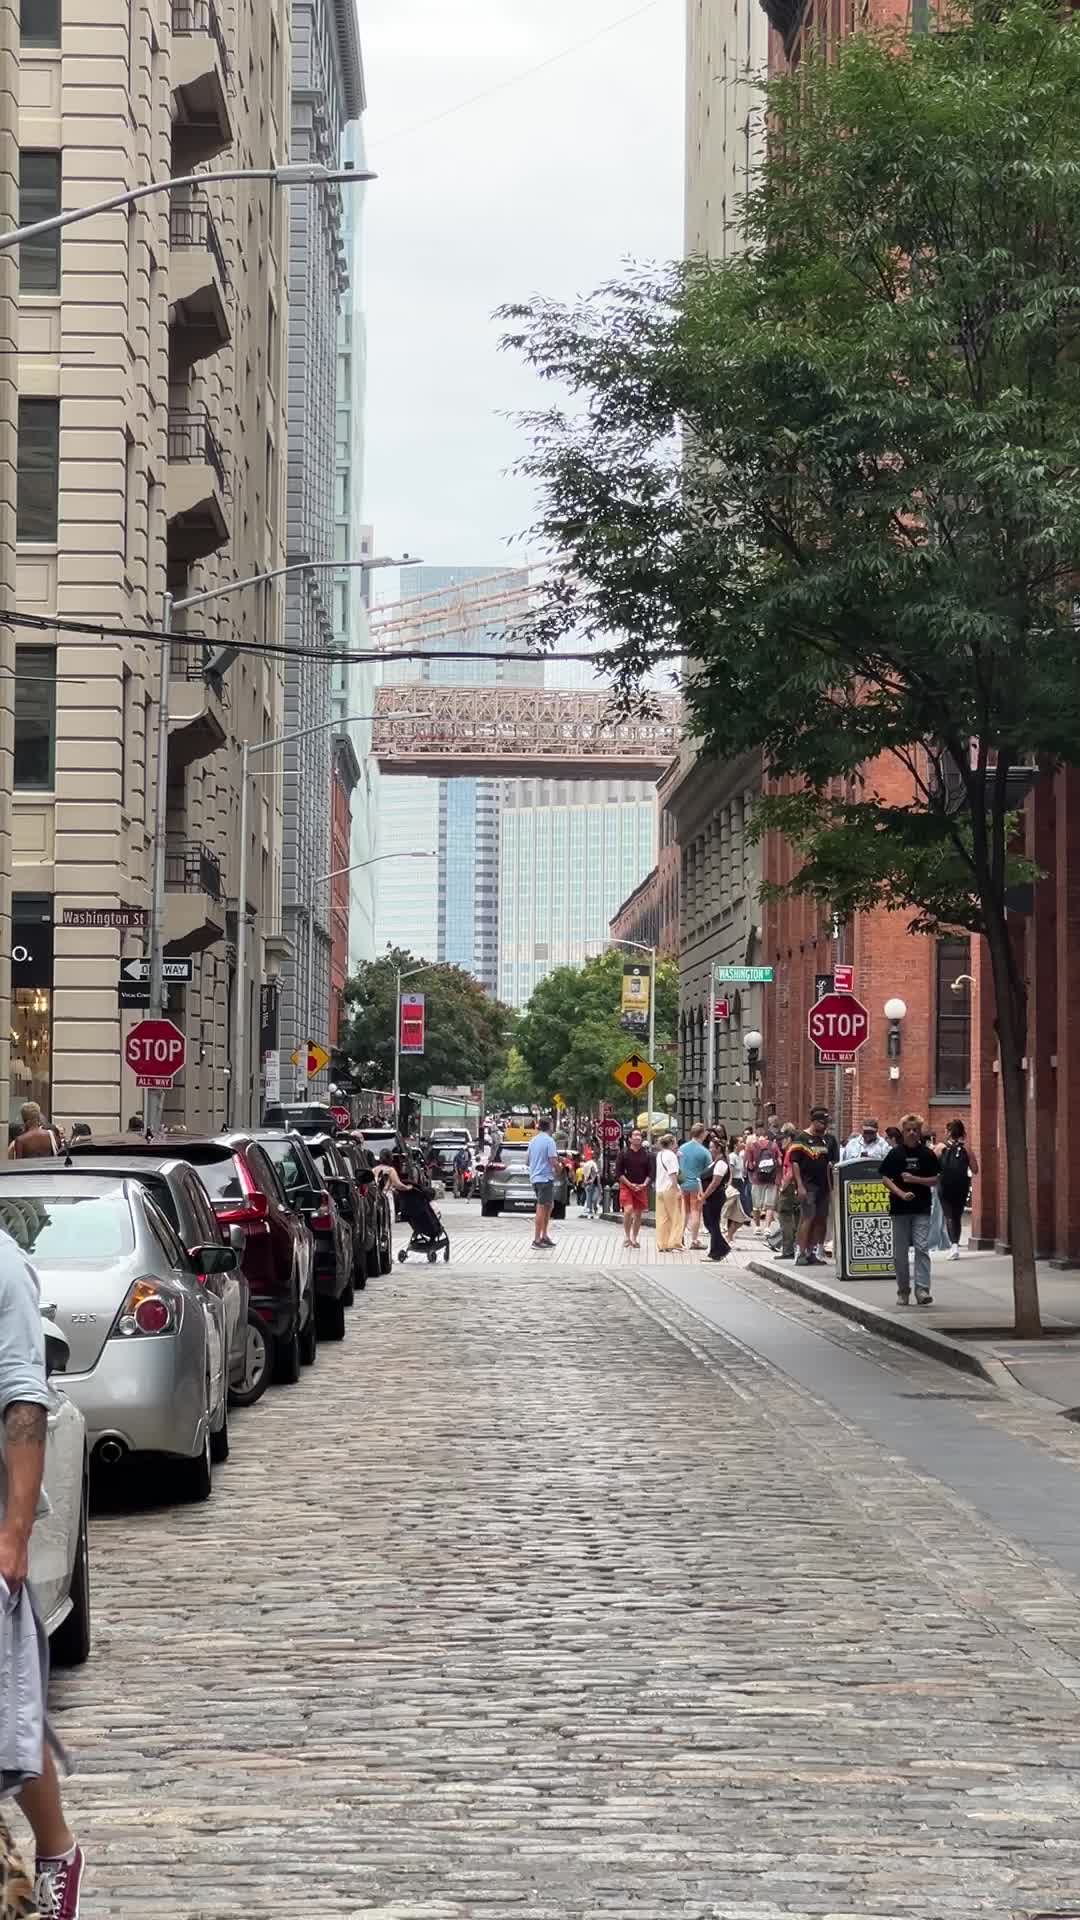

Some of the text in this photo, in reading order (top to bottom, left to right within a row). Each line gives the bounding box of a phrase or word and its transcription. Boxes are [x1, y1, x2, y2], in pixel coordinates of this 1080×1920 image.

[63, 911, 145, 927] Washington St
[164, 965, 185, 975] WAY
[719, 967, 764, 979] WASHINGTON
[812, 1014, 865, 1037] STOP
[128, 1038, 182, 1062] STOP
[823, 1053, 853, 1061] ALL WAY
[155, 1078, 170, 1086] WAY
[336, 1114, 349, 1126] OP
[598, 1126, 620, 1137] STOP
[850, 1183, 889, 1193] WHER
[851, 1202, 867, 1213] WE
